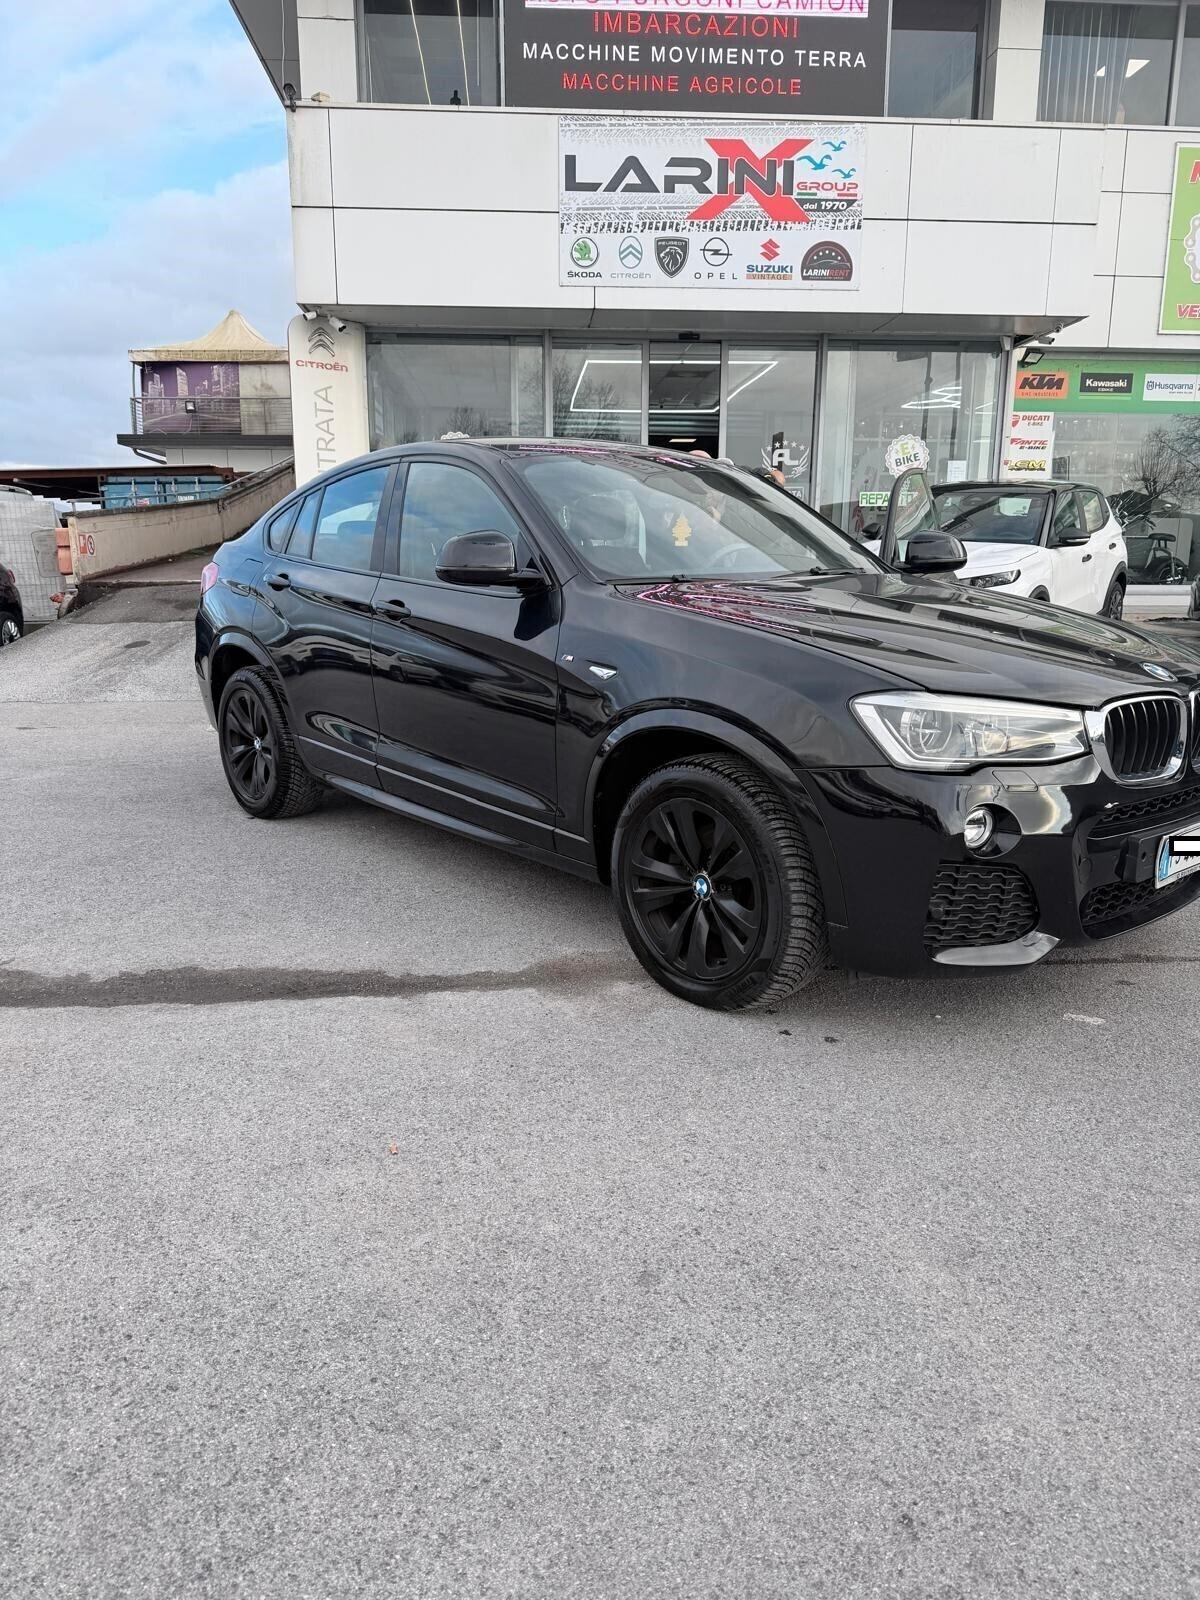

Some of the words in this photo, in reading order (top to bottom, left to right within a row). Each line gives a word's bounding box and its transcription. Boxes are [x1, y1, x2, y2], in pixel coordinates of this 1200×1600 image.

[594, 11, 798, 38] IMBARCAZIONI
[523, 43, 640, 62] MACCHINE
[651, 46, 784, 66] MOVIMENTO
[795, 50, 866, 68] TERRA
[562, 73, 679, 92] MACCHINE
[689, 76, 801, 95] AGRICOLE
[564, 154, 795, 195] LARINI
[796, 181, 859, 191] GROUP
[820, 201, 847, 210] 1970
[746, 264, 793, 273] SUZUKI
[567, 270, 603, 278] ŠKODA
[694, 272, 738, 280] OPEL
[1176, 303, 1200, 319] VE
[1018, 373, 1064, 390] KTM
[1086, 378, 1127, 388] Kawasaki
[1154, 381, 1194, 391] Husqvarna
[1010, 437, 1049, 446] FANTIC
[894, 452, 921, 467] BIKE
